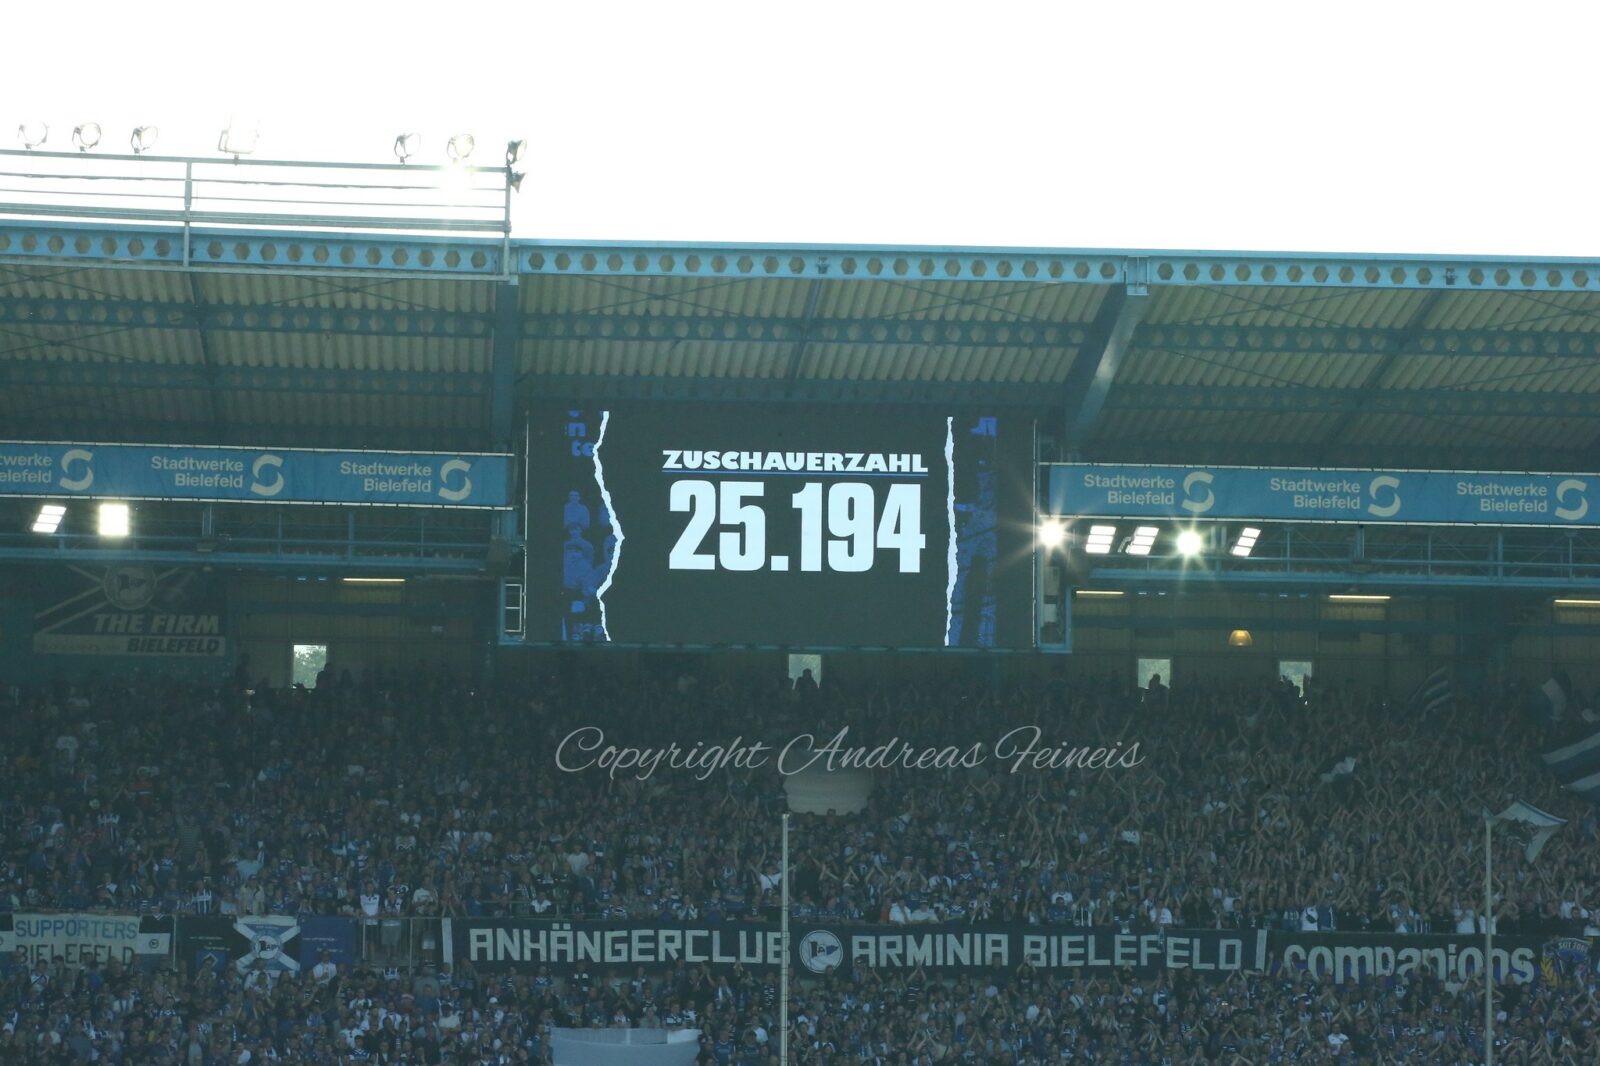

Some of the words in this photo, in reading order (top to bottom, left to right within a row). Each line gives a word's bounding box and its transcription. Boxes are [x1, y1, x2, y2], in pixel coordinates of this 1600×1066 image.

[151, 456, 244, 472] Stadtwerke
[662, 450, 928, 472] ZUSCHAUERZAHL
[340, 461, 432, 477] Stadtwerke
[175, 473, 243, 488] Bielefeld
[364, 478, 431, 492] Bielefeld
[1084, 474, 1175, 489] Stadtwerke
[1270, 478, 1361, 493] Stadtwerke
[1456, 482, 1547, 496] Stadtwerke
[1108, 490, 1174, 505] Bielefeld
[1294, 495, 1360, 509] Bielefeld
[1480, 498, 1548, 512] Bielefeld
[669, 480, 926, 573] 25.194
[93, 614, 145, 633] THE
[150, 614, 220, 634] FIRM
[126, 638, 219, 654] BIELEFELD
[15, 918, 138, 941] SUPPORTERS
[470, 922, 791, 963] ANHÄNGERCLUB
[851, 933, 1009, 968] ARMINIA
[1023, 934, 1242, 971] BIELEFELD
